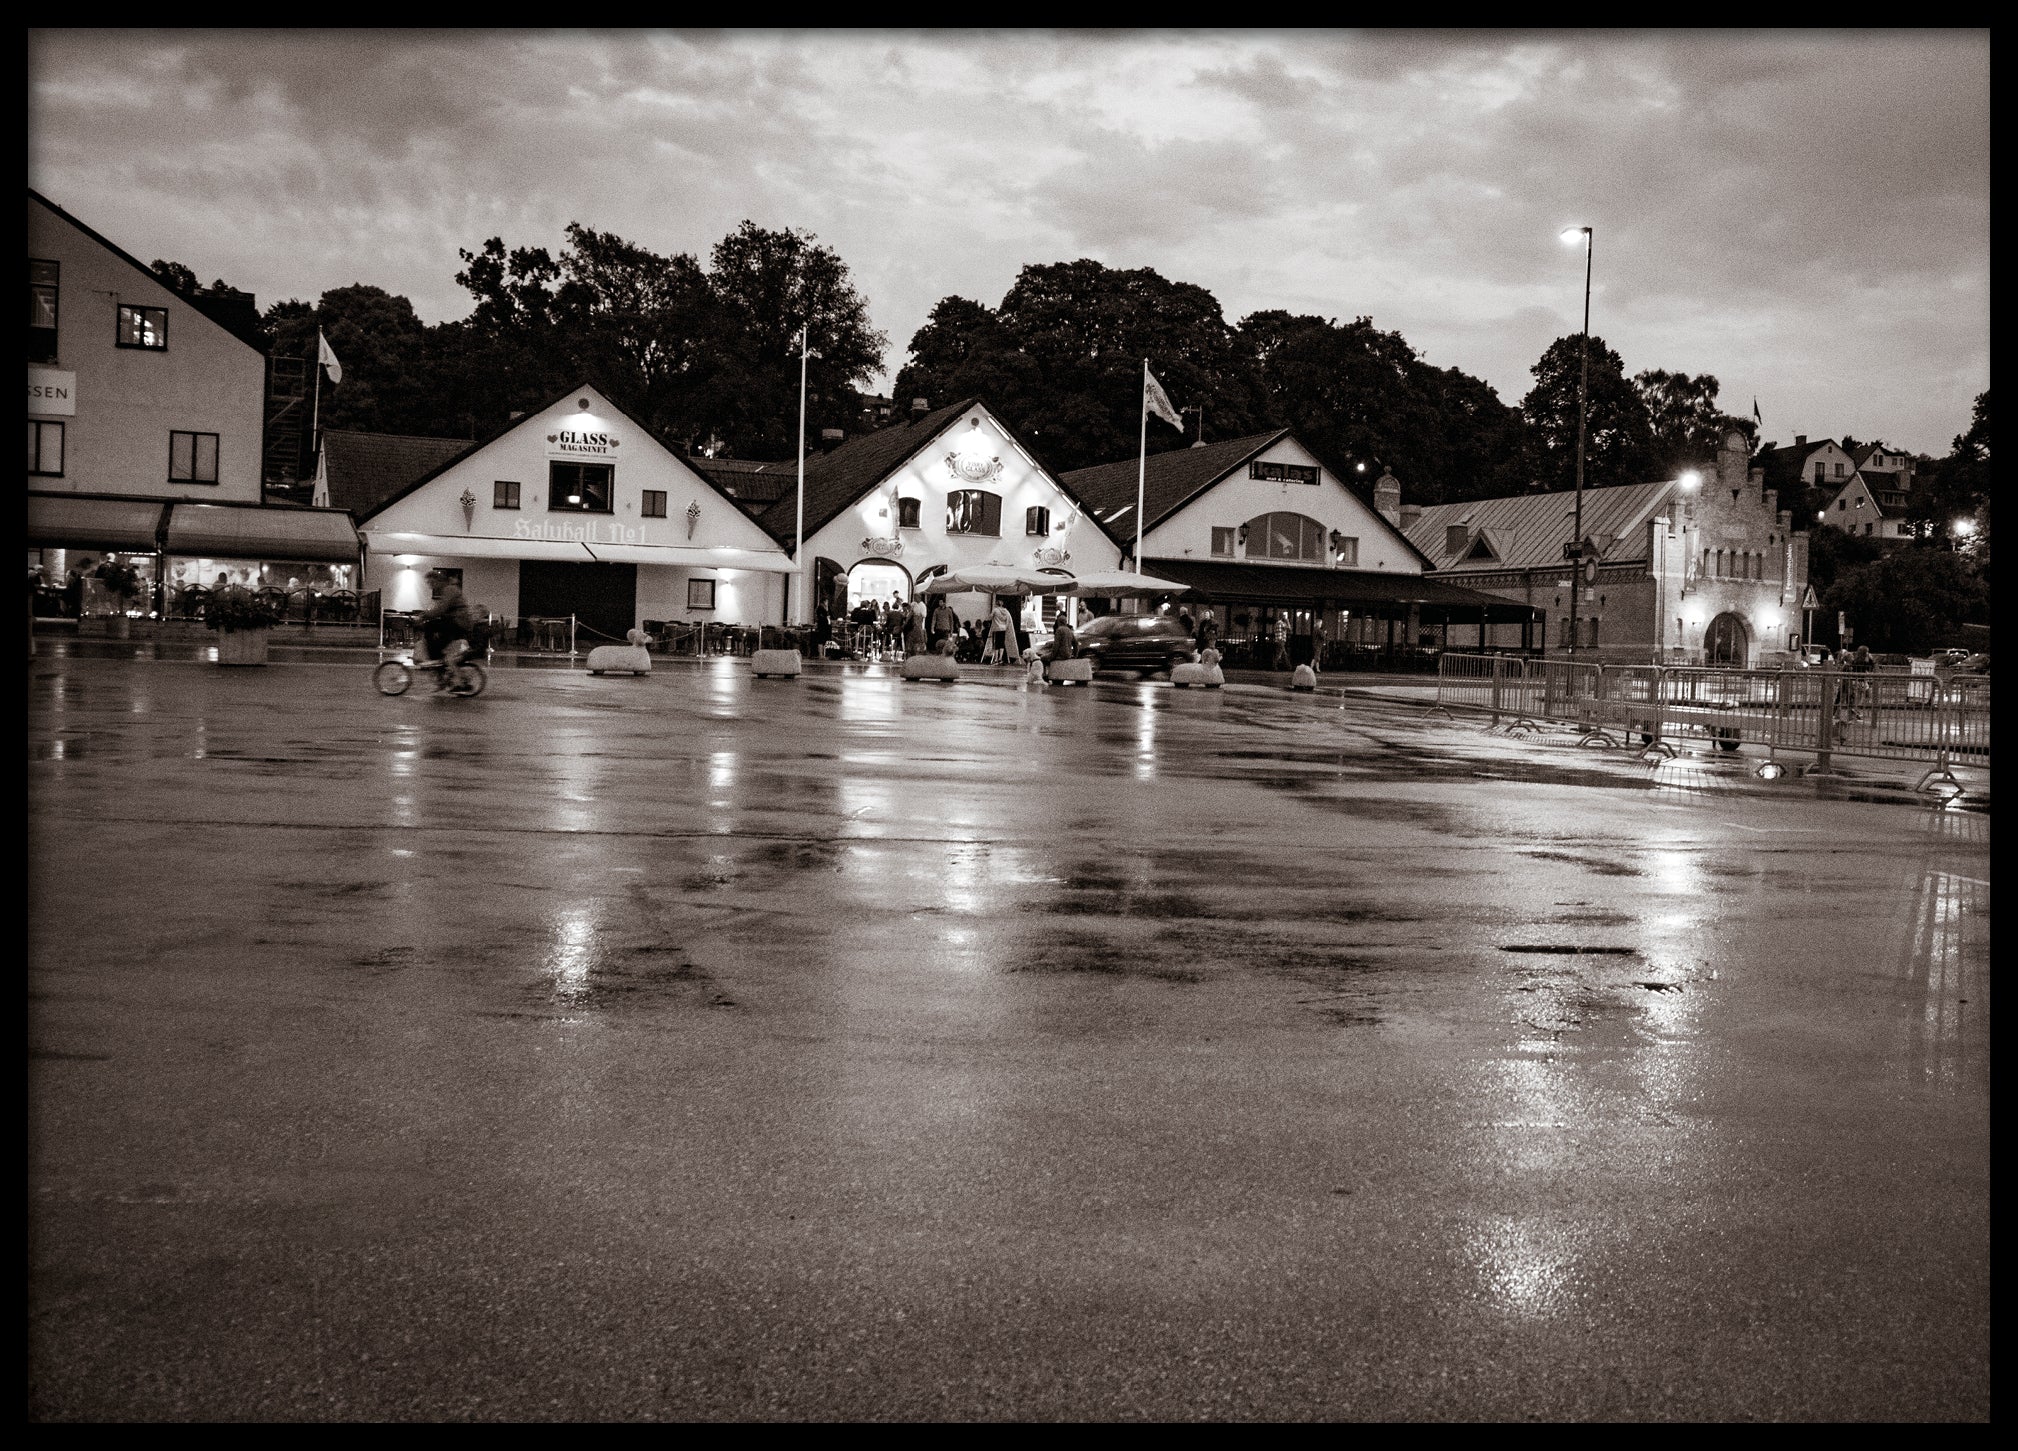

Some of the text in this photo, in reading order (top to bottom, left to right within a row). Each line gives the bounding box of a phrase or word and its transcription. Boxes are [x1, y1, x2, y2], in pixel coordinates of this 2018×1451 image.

[28, 385, 68, 399] SEN
[560, 431, 607, 446] GLASS
[560, 443, 607, 453] MAGASINET
[1258, 462, 1312, 480] kalas
[513, 518, 598, 541] Saluhall
